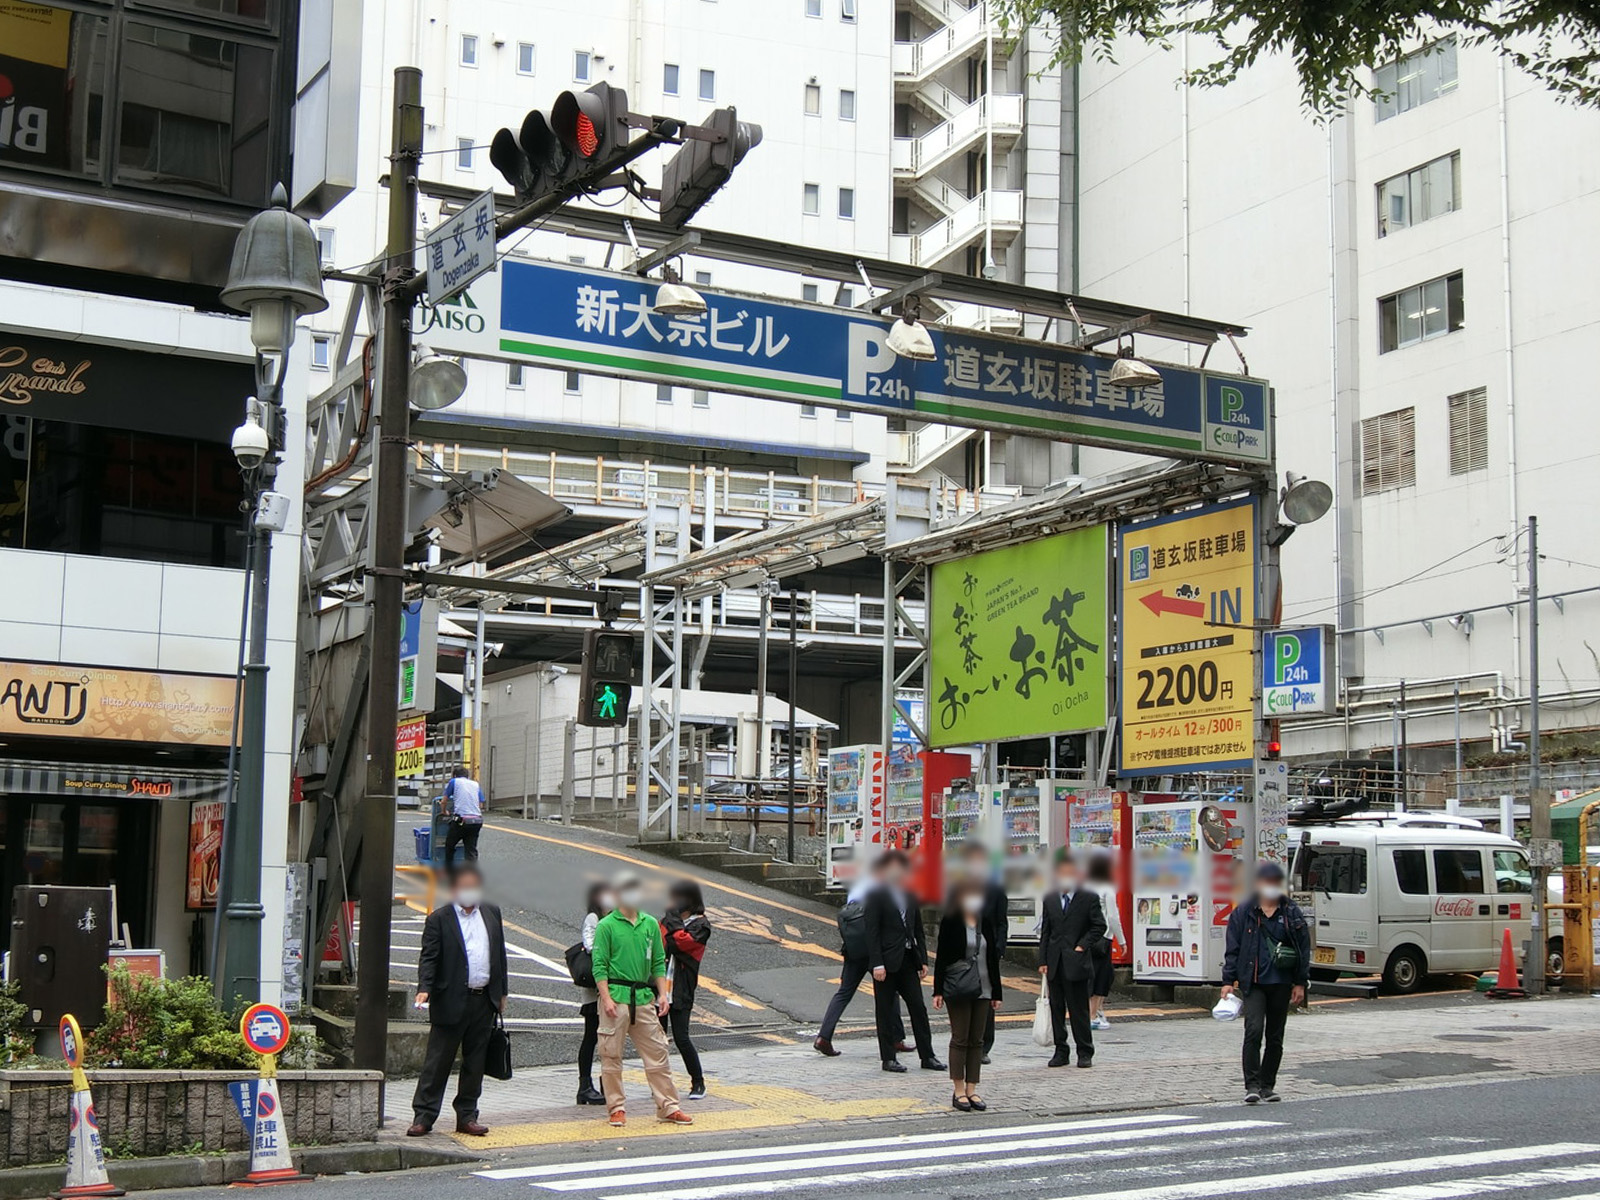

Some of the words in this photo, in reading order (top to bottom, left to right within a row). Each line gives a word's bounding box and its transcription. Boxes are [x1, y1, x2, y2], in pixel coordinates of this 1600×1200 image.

[432, 204, 488, 272] 道玄坂
[442, 252, 480, 288] Dogenzaka
[418, 305, 485, 334] TAISO
[848, 322, 897, 396] P
[869, 375, 910, 400] 24h
[1221, 385, 1244, 423] P
[1231, 412, 1250, 425] 24h
[1153, 530, 1246, 571] 道玄坂駐車場
[987, 606, 1006, 622] GREEN
[1006, 599, 1018, 611] TEA
[1018, 587, 1039, 604] BRAND
[1210, 586, 1242, 628] IN
[1275, 634, 1301, 685] P
[1286, 665, 1309, 682] 24h
[88, 671, 118, 681] Dining
[1052, 701, 1064, 716] Oi
[1065, 690, 1089, 710] Ocha
[1136, 725, 1181, 741] オールタイム
[65, 780, 83, 788] Soup
[84, 781, 103, 789] Curry
[105, 782, 127, 790] Dining
[1148, 951, 1185, 968] KIRIN
